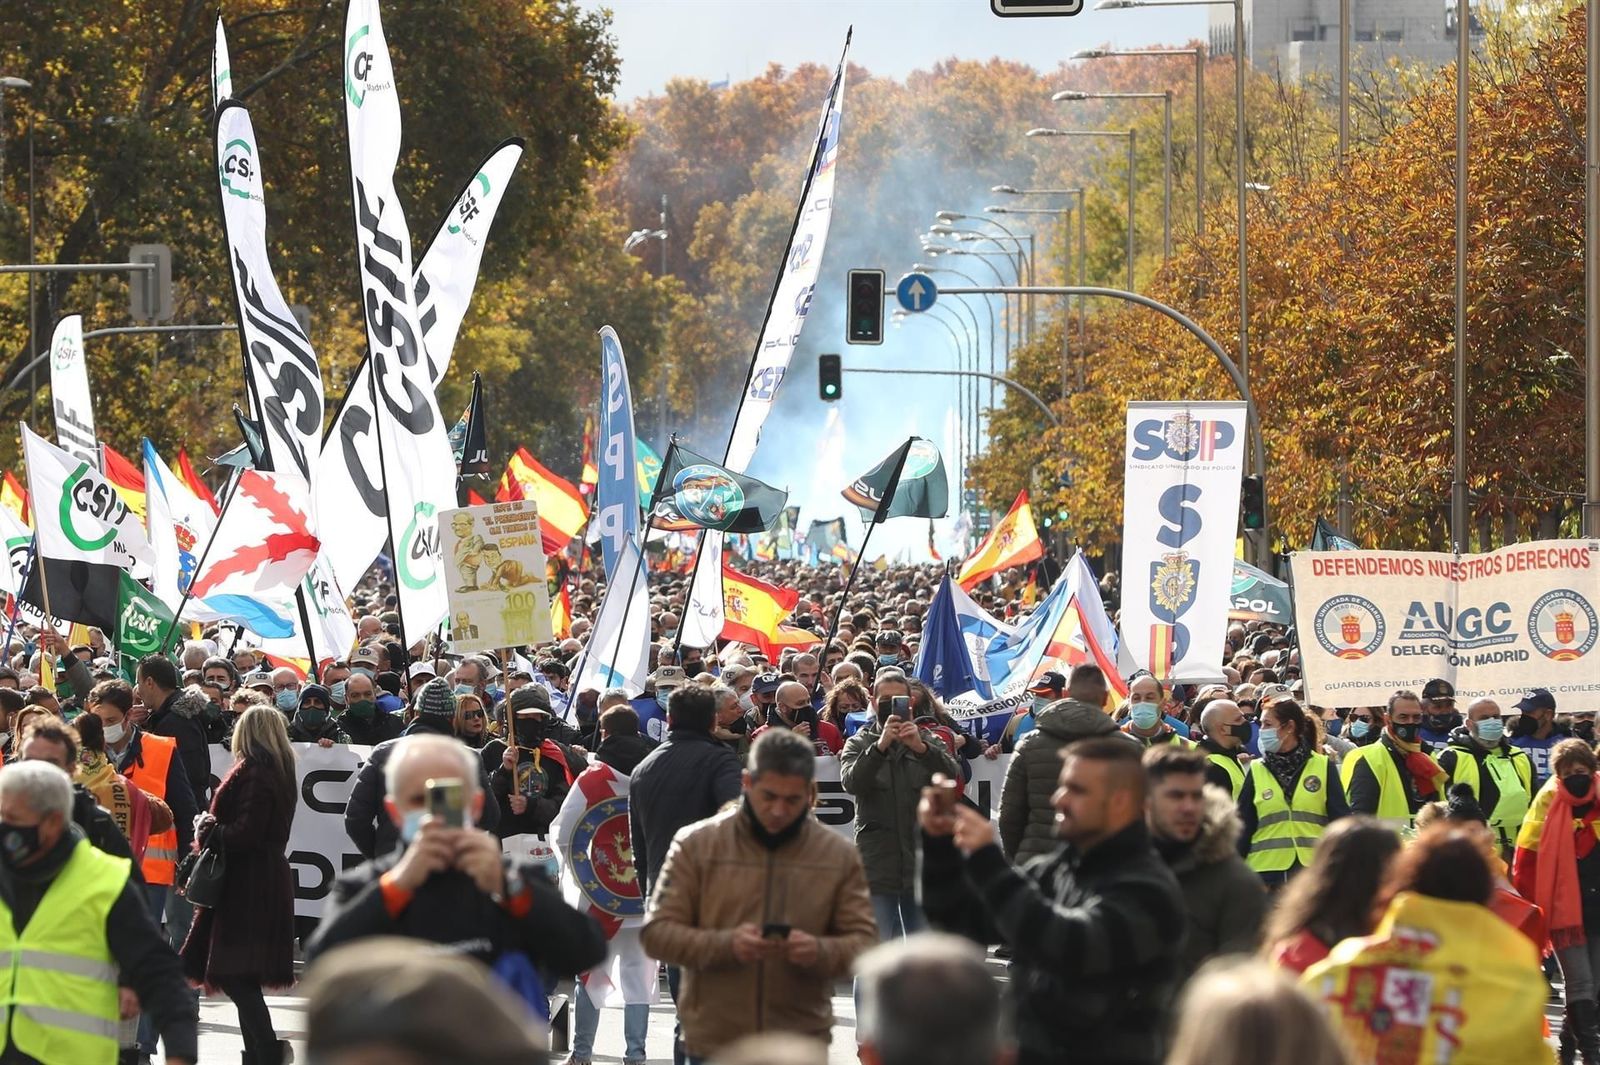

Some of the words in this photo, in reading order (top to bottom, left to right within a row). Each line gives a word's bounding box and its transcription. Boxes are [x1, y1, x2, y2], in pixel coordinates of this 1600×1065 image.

[1131, 418, 1236, 462] SUP
[1312, 557, 1424, 577] DEFENDEMOS
[1428, 554, 1503, 582] NUESTROS
[1505, 547, 1591, 573] DERECHOS
[505, 591, 536, 609] 100
[1403, 600, 1513, 641] AUGC
[1474, 649, 1531, 667] MADRID
[1324, 680, 1382, 691] GUARDIAS
[1384, 678, 1427, 689] CIVILES
